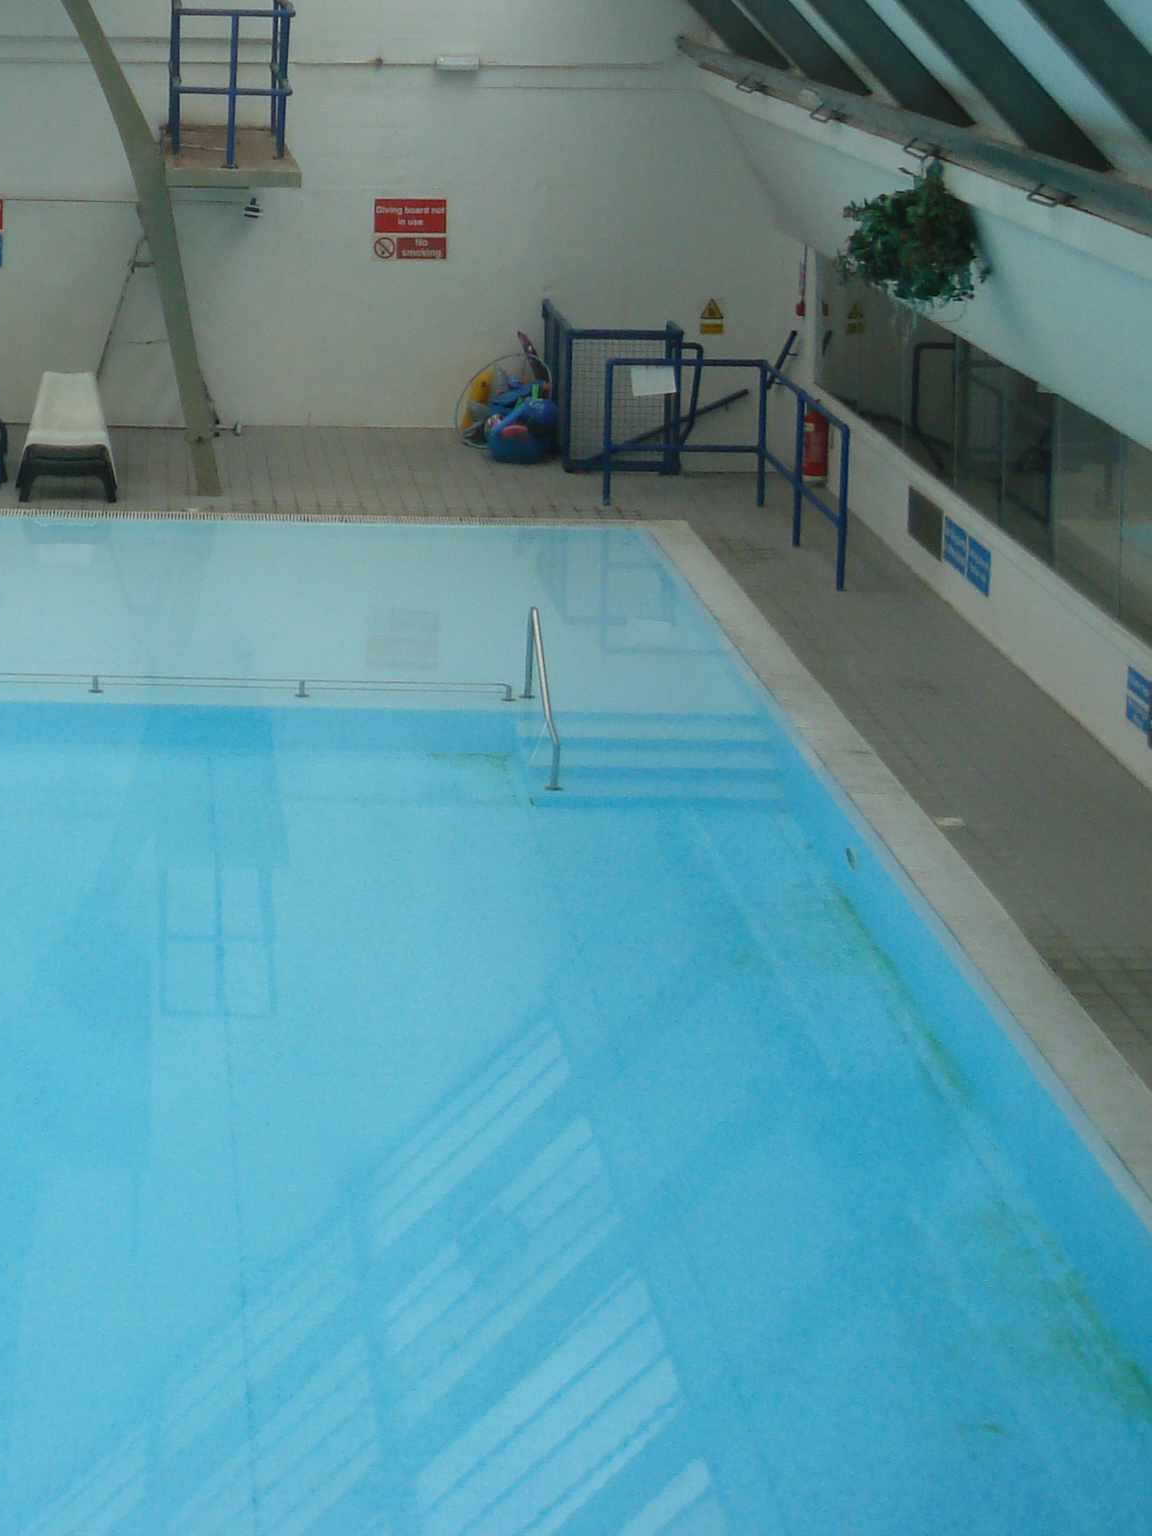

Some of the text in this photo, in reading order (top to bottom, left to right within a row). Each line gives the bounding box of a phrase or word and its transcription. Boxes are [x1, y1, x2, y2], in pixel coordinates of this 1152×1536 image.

[376, 205, 445, 215] Diving board not
[397, 218, 406, 226] in
[415, 239, 428, 247] No
[401, 248, 442, 259] smoking
